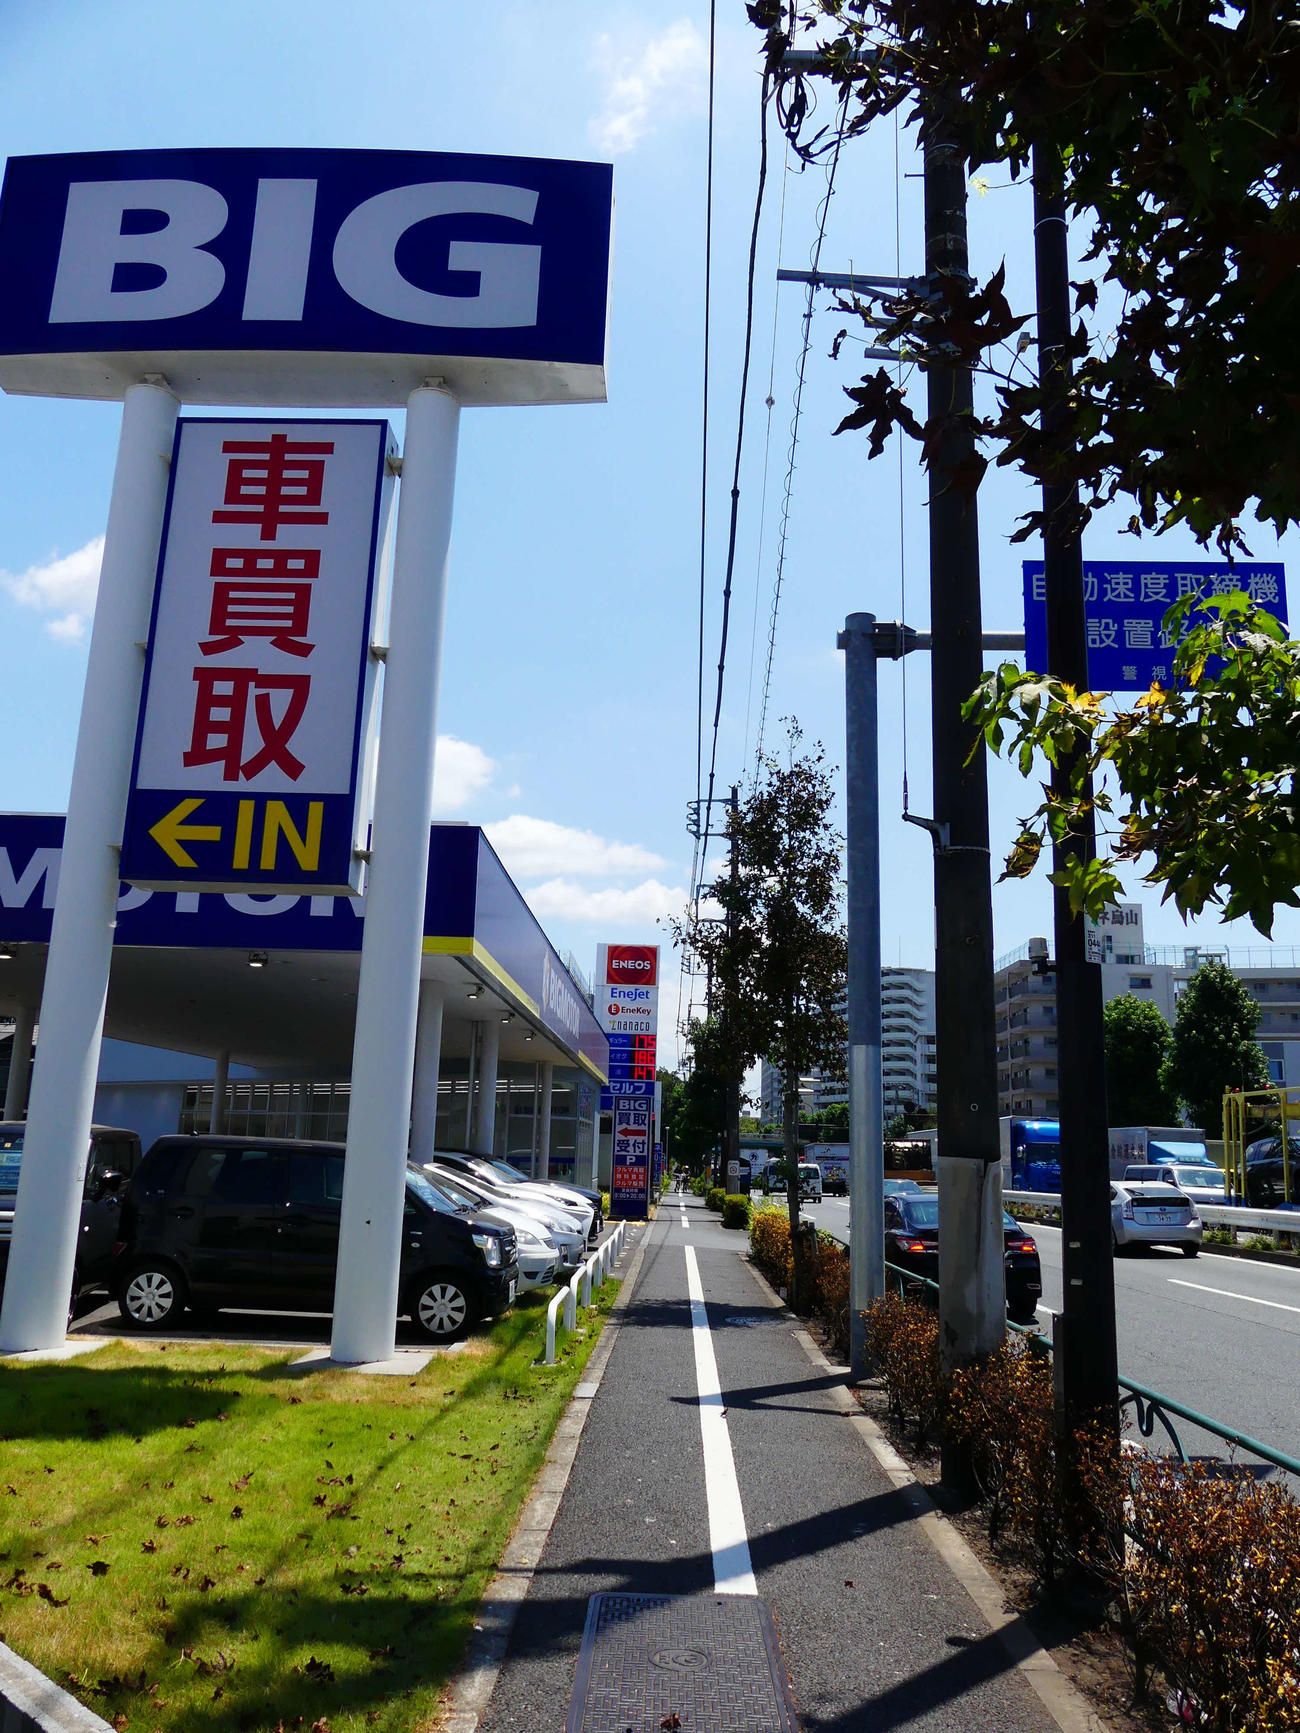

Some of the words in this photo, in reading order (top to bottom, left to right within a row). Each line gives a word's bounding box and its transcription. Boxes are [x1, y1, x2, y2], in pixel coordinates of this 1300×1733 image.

[48, 178, 541, 328] BIG
[183, 434, 335, 783] 車買取
[1087, 618, 1221, 650] 設置路
[1122, 665, 1184, 681] 警視
[232, 800, 325, 872] IN
[612, 959, 651, 970] ENEOS
[621, 1006, 652, 1016] EneKey
[617, 1020, 650, 1031] nanaco
[635, 1034, 656, 1048] 175
[634, 1050, 655, 1064] 186
[634, 1067, 655, 1080] 147
[609, 1081, 646, 1094] セルフ
[619, 1100, 647, 1110] BIG
[617, 1112, 647, 1126] 買取
[616, 1139, 646, 1154] 受付
[626, 1155, 636, 1165] P
